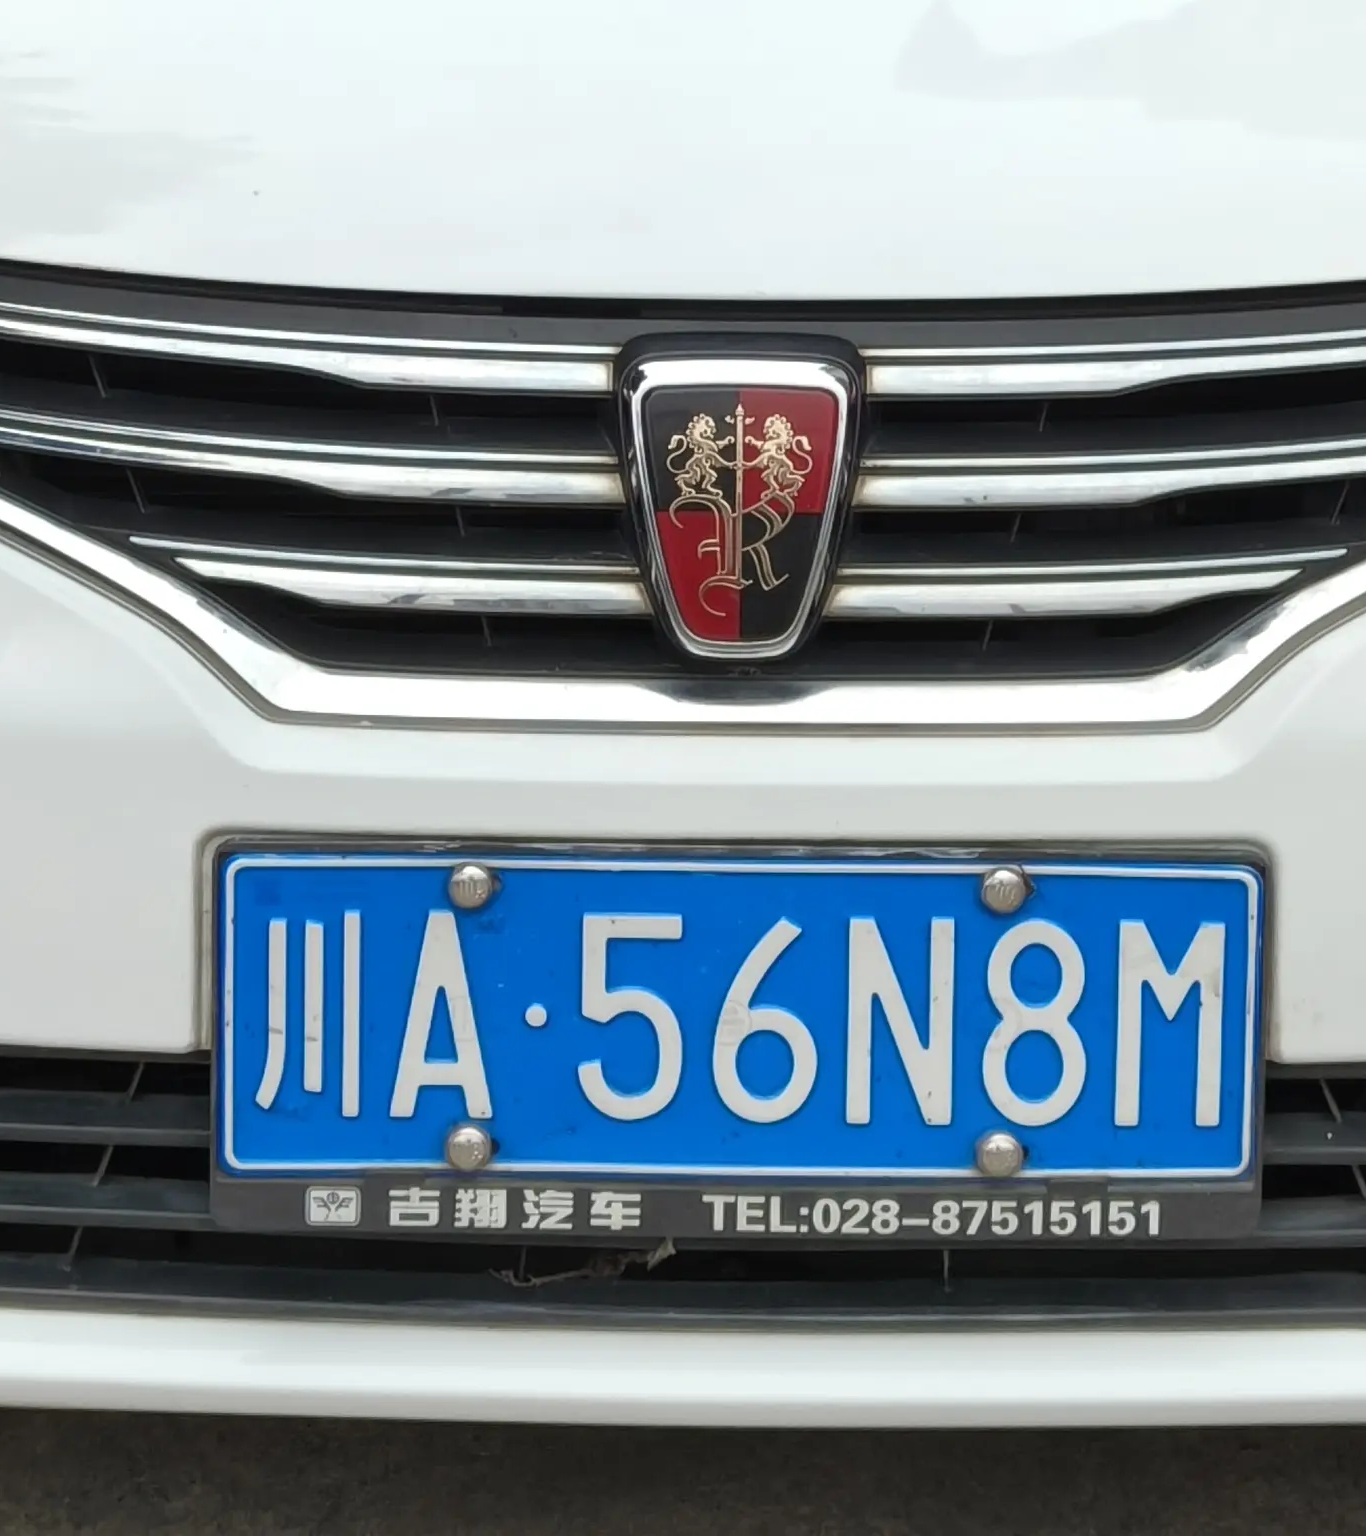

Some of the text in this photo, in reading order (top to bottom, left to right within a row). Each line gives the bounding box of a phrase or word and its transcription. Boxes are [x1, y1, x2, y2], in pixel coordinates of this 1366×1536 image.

[388, 1186, 642, 1231] 吉翔汽车
[701, 1194, 1160, 1236] TEL:028-87515151
